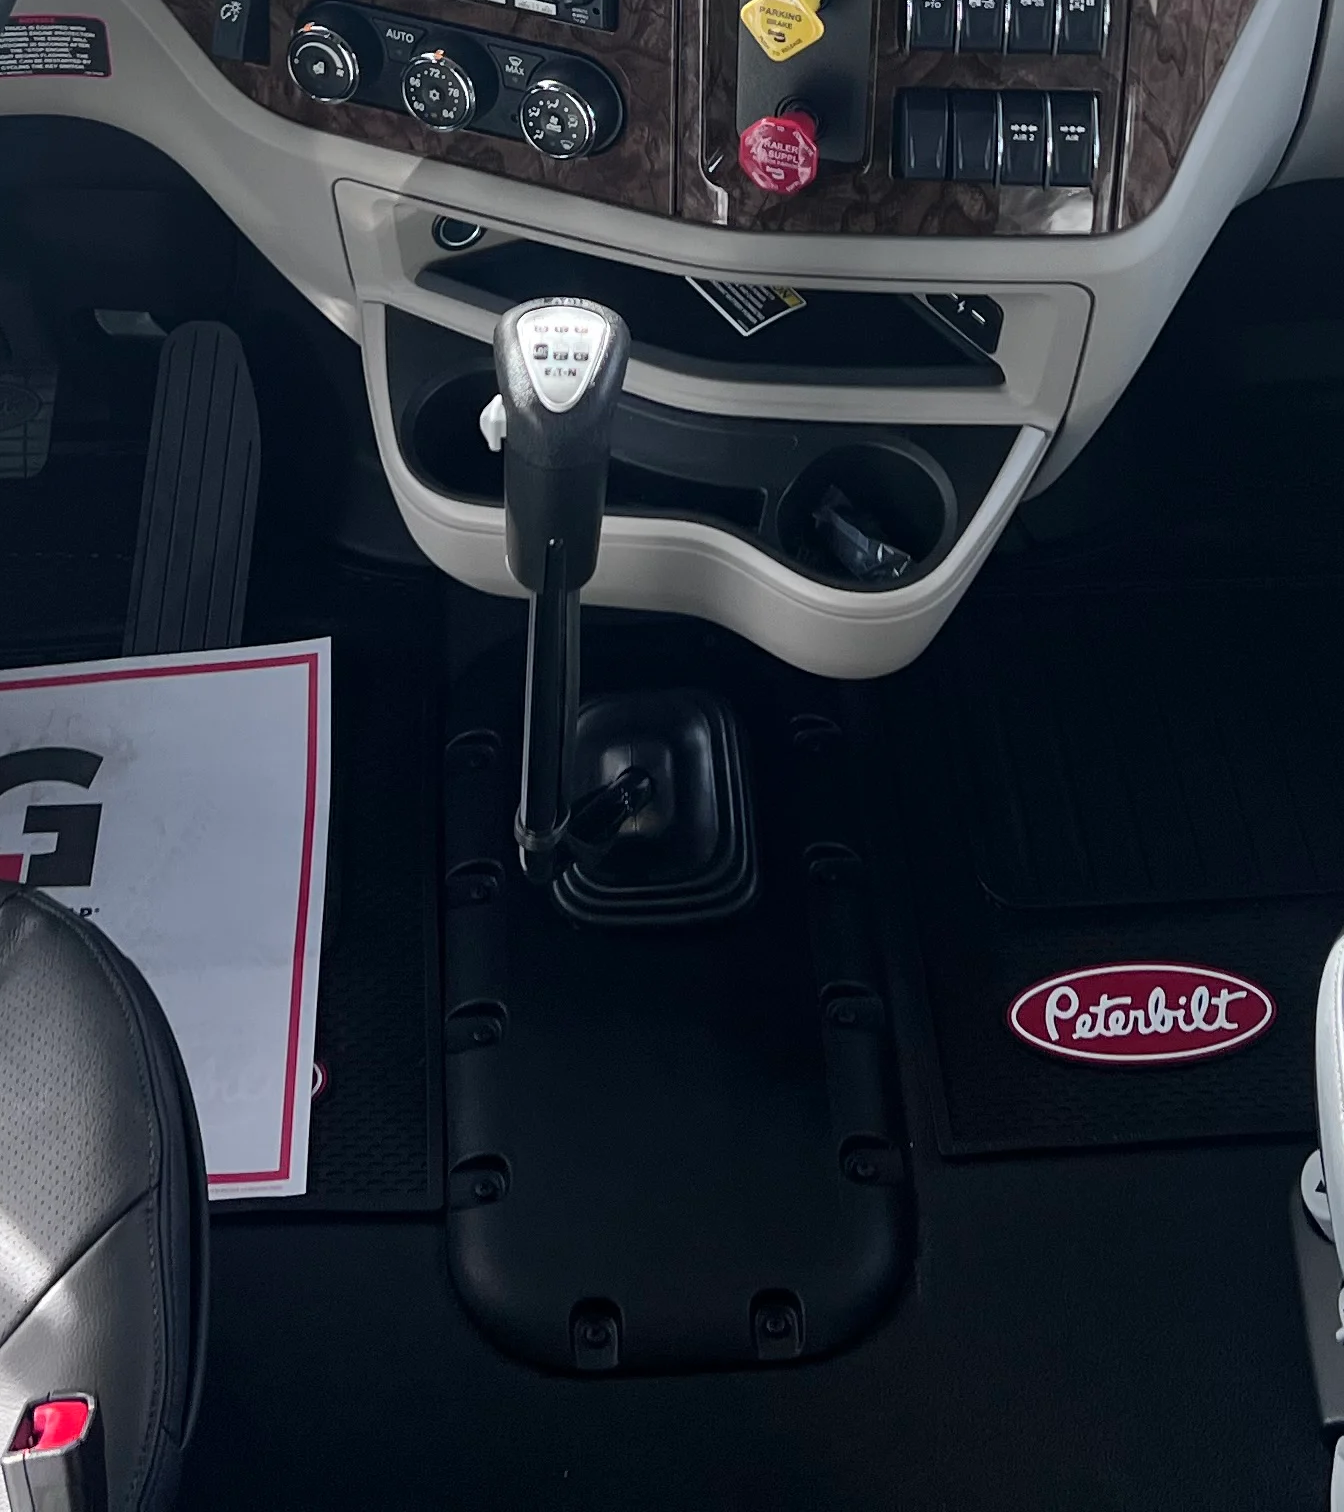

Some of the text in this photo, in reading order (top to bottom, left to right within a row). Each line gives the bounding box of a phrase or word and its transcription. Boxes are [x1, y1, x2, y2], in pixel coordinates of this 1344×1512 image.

[924, 1, 942, 9] PTO
[759, 5, 803, 24] PARKING
[385, 28, 414, 44] AUTO
[428, 67, 441, 79] 72
[505, 65, 525, 77] MAX
[409, 76, 421, 88] 66
[1012, 133, 1027, 141] AIR
[1065, 134, 1079, 142] AIR
[1045, 985, 1248, 1041] Peterbilt
